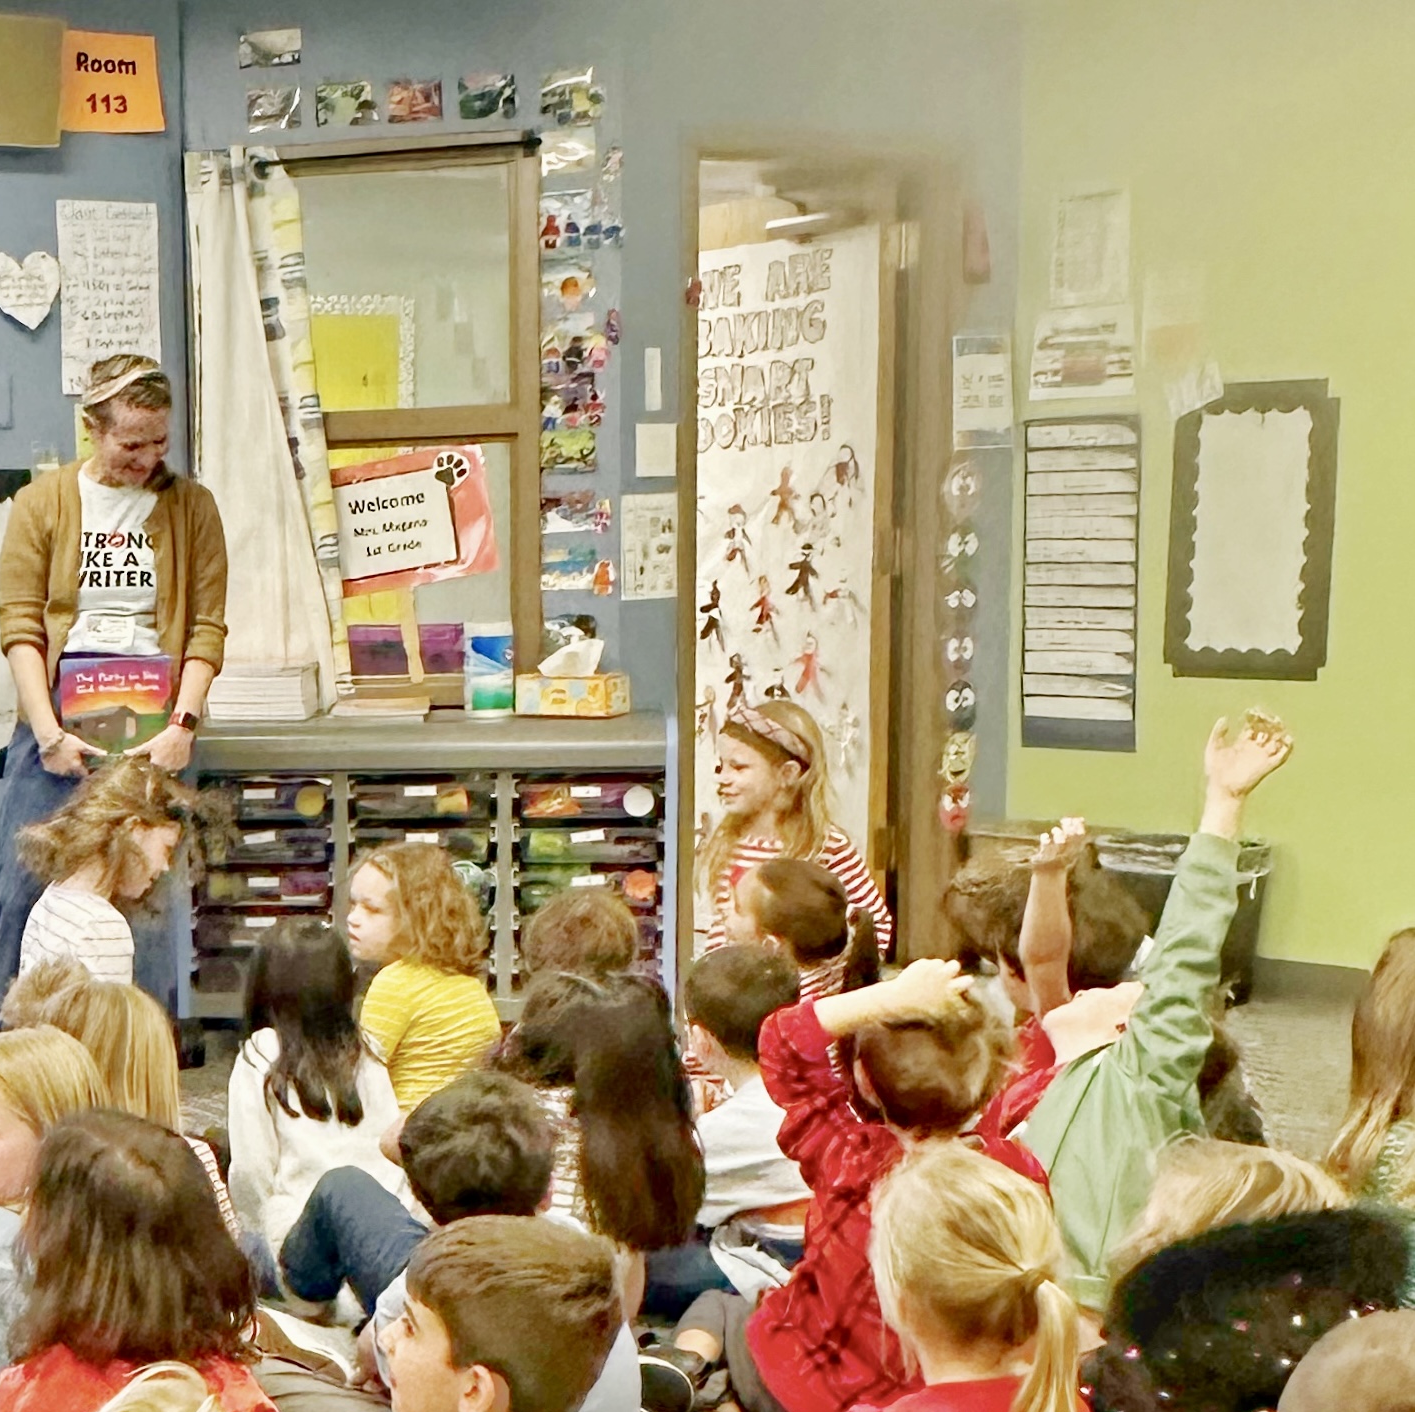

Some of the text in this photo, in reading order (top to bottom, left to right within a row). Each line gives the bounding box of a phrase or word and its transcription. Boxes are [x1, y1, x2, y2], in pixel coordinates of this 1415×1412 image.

[76, 52, 137, 75] Room
[86, 93, 128, 114] 113
[765, 248, 833, 302] ARE
[698, 394, 832, 453] OOKIES!
[348, 492, 425, 515] Welcome
[83, 532, 154, 550] TRON
[123, 551, 140, 567] A
